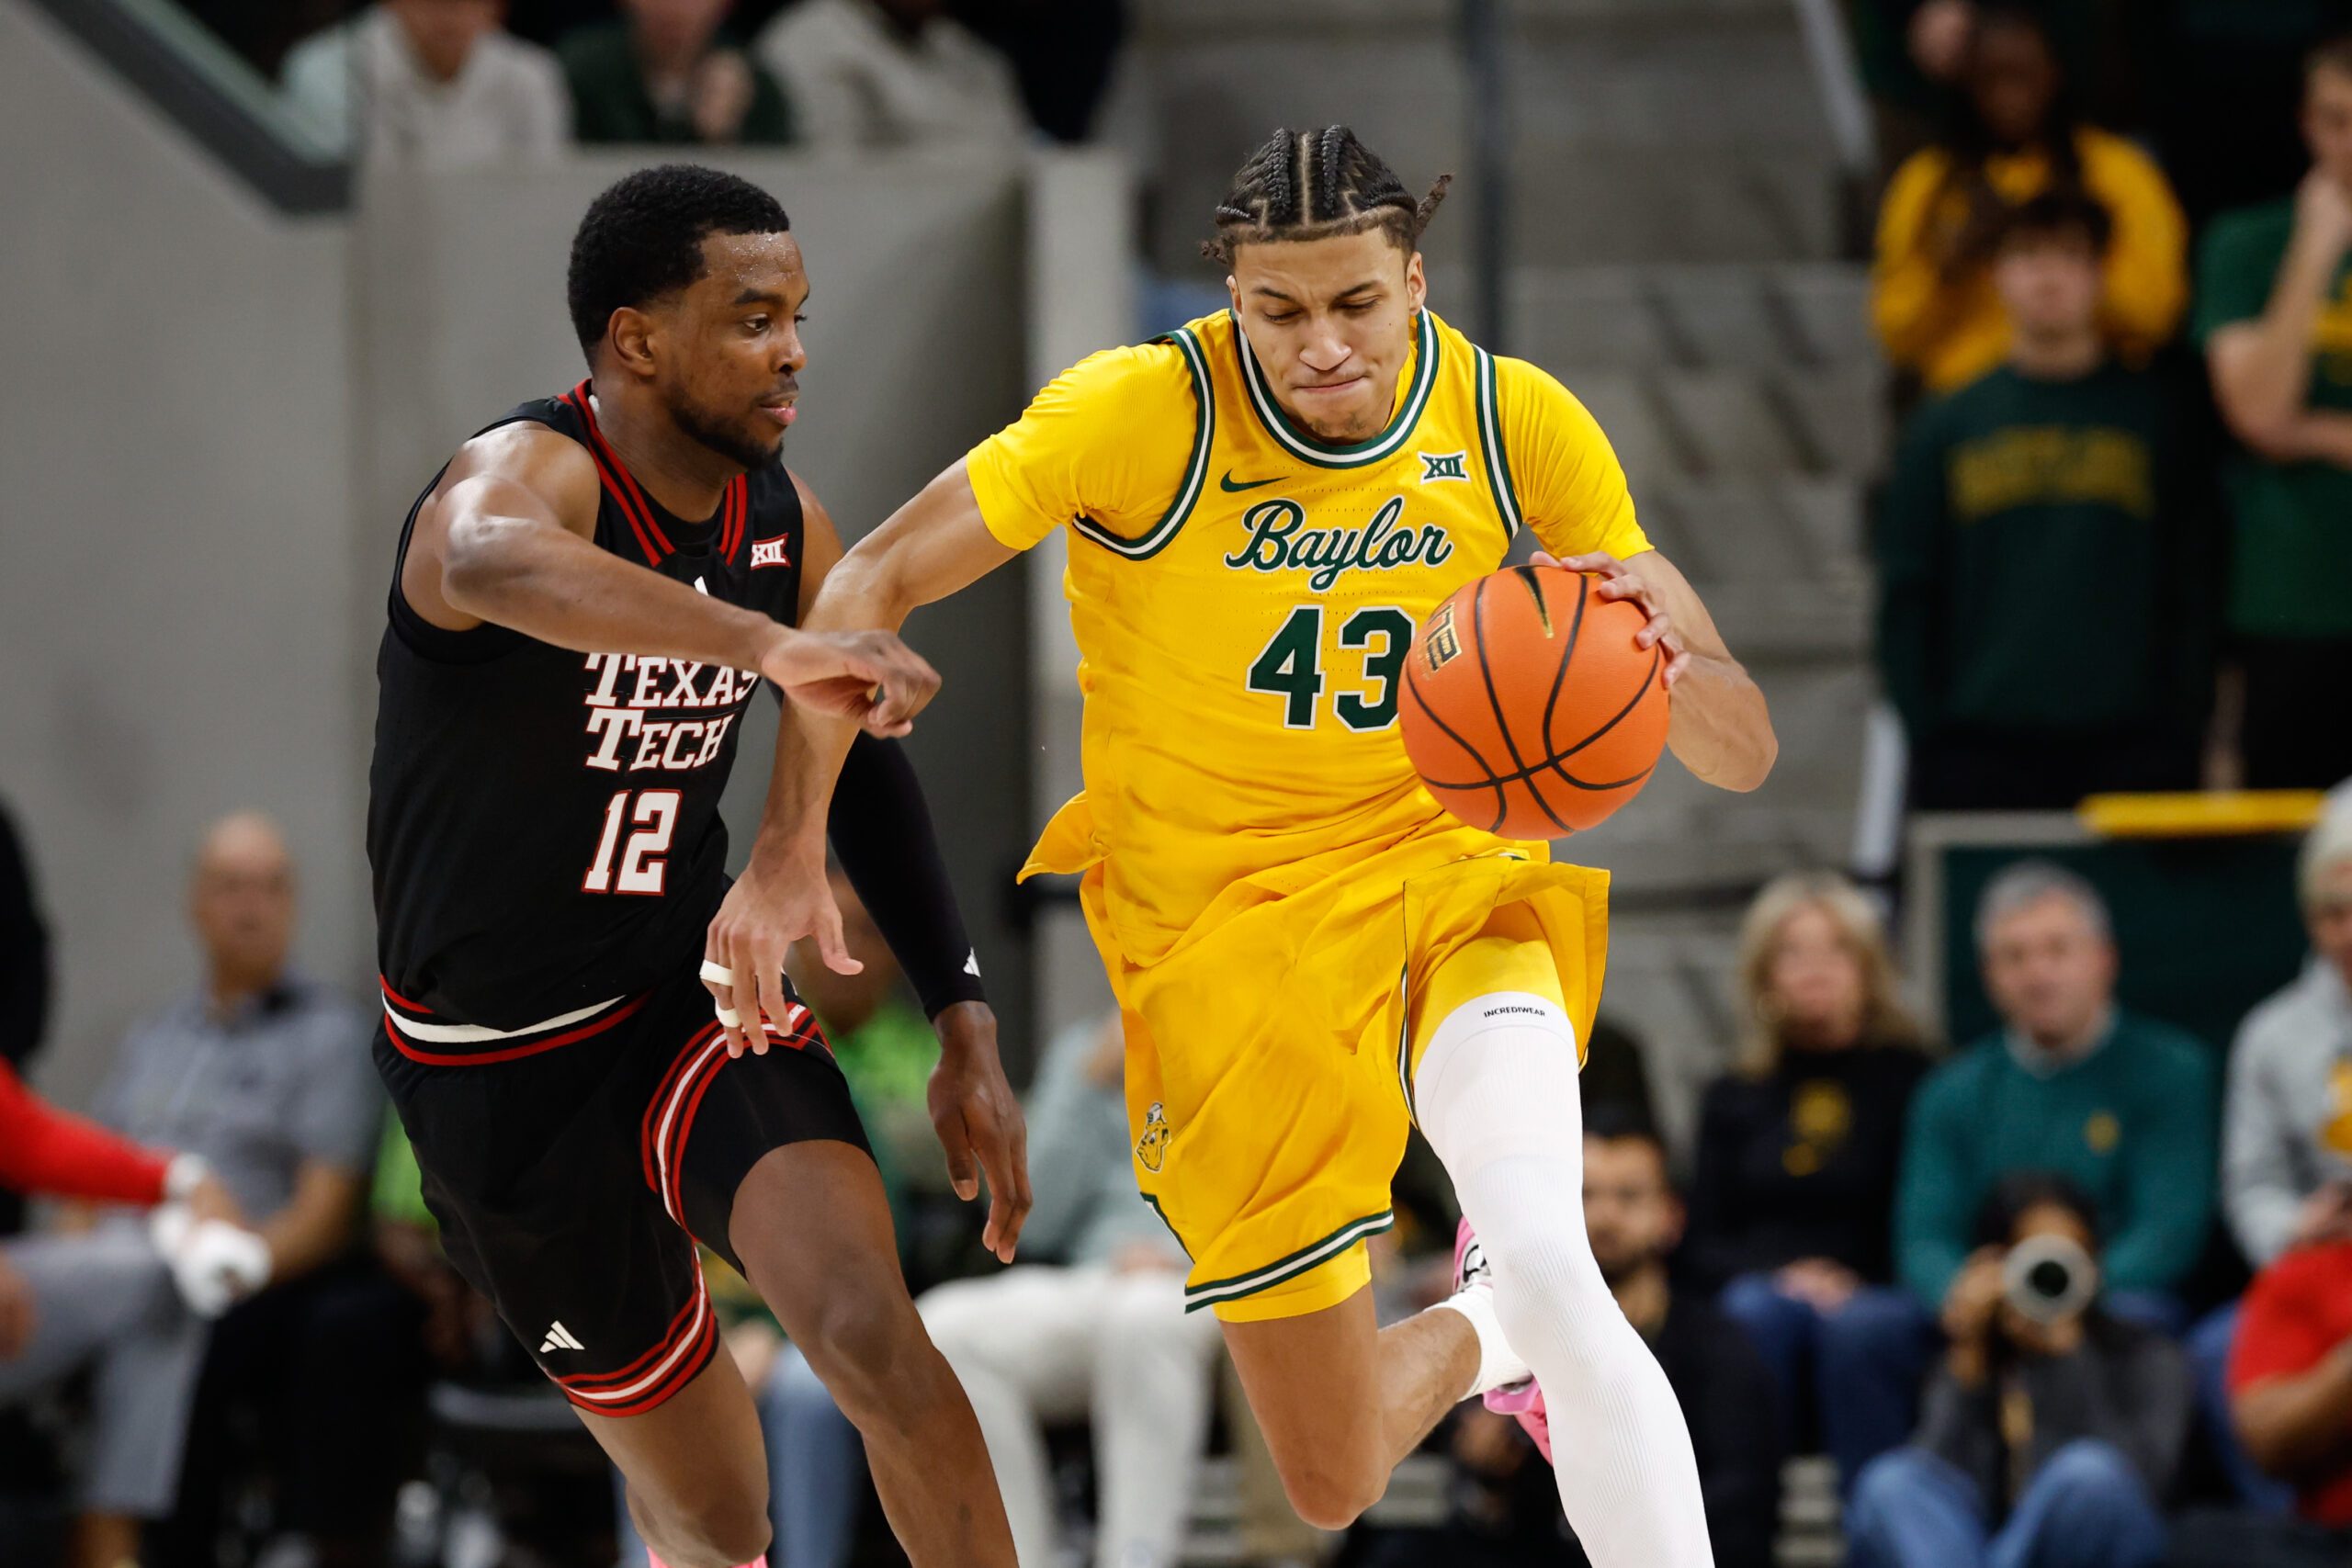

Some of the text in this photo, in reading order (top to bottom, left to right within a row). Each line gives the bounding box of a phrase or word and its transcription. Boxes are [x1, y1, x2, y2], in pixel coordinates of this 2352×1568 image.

[1423, 454, 1466, 479] XII
[750, 537, 787, 568] XII
[1224, 495, 1453, 592] Baylor
[583, 653, 760, 707] TEXAS
[1246, 604, 1416, 733] 43
[584, 706, 734, 772] TECH
[582, 787, 684, 897] 12
[1484, 1006, 1544, 1018] INCREDIWEAR
